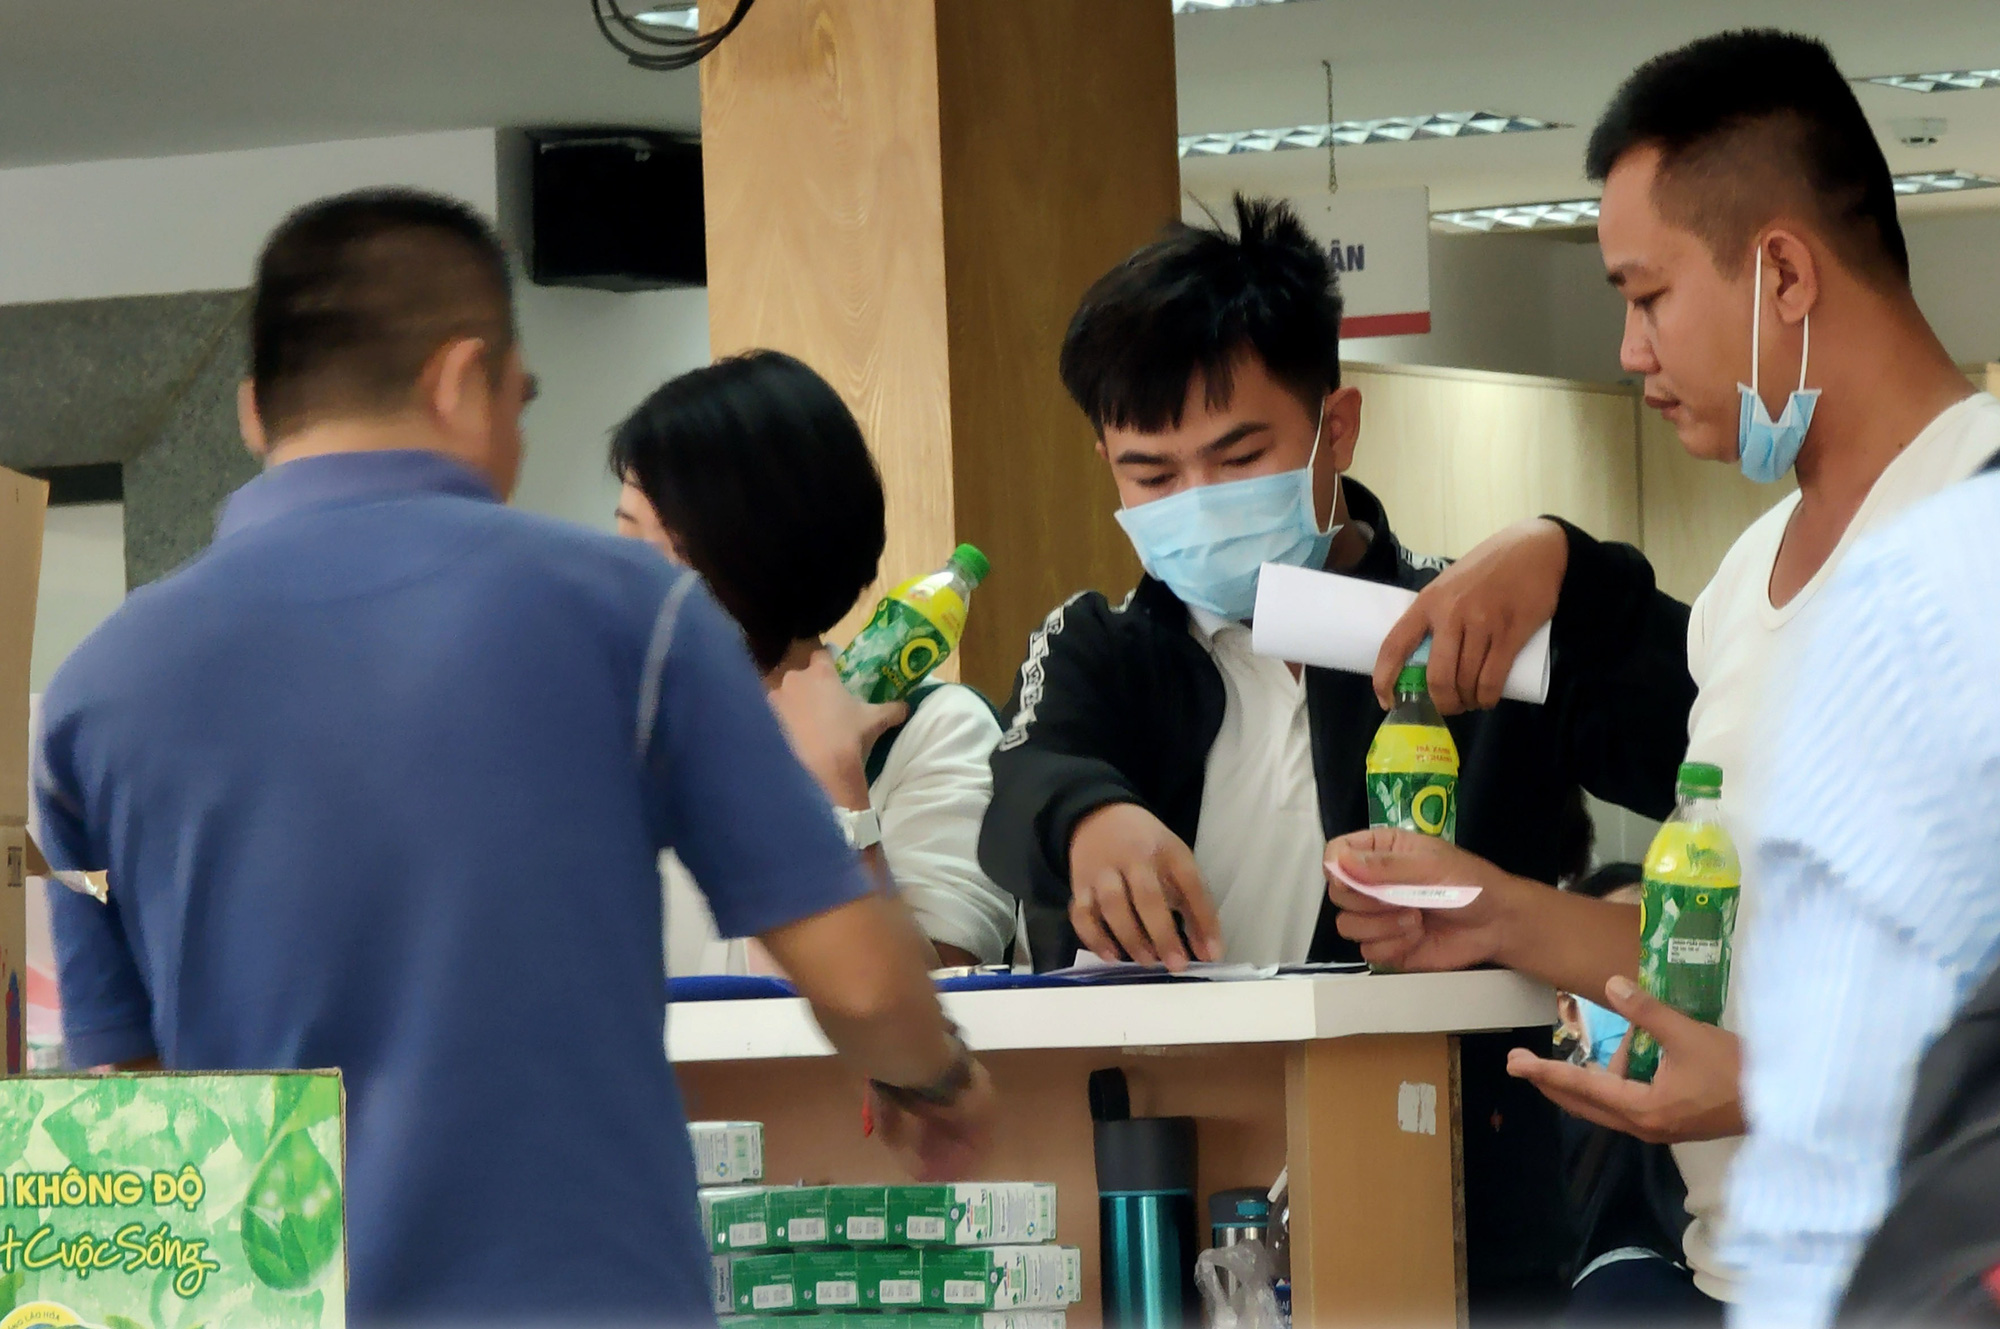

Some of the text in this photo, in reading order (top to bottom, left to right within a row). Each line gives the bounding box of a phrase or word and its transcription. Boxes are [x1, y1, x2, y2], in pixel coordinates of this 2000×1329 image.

[15, 1165, 144, 1207] KHÔNG
[153, 1164, 204, 1211] ĐỘ
[116, 1225, 218, 1296] Sống
